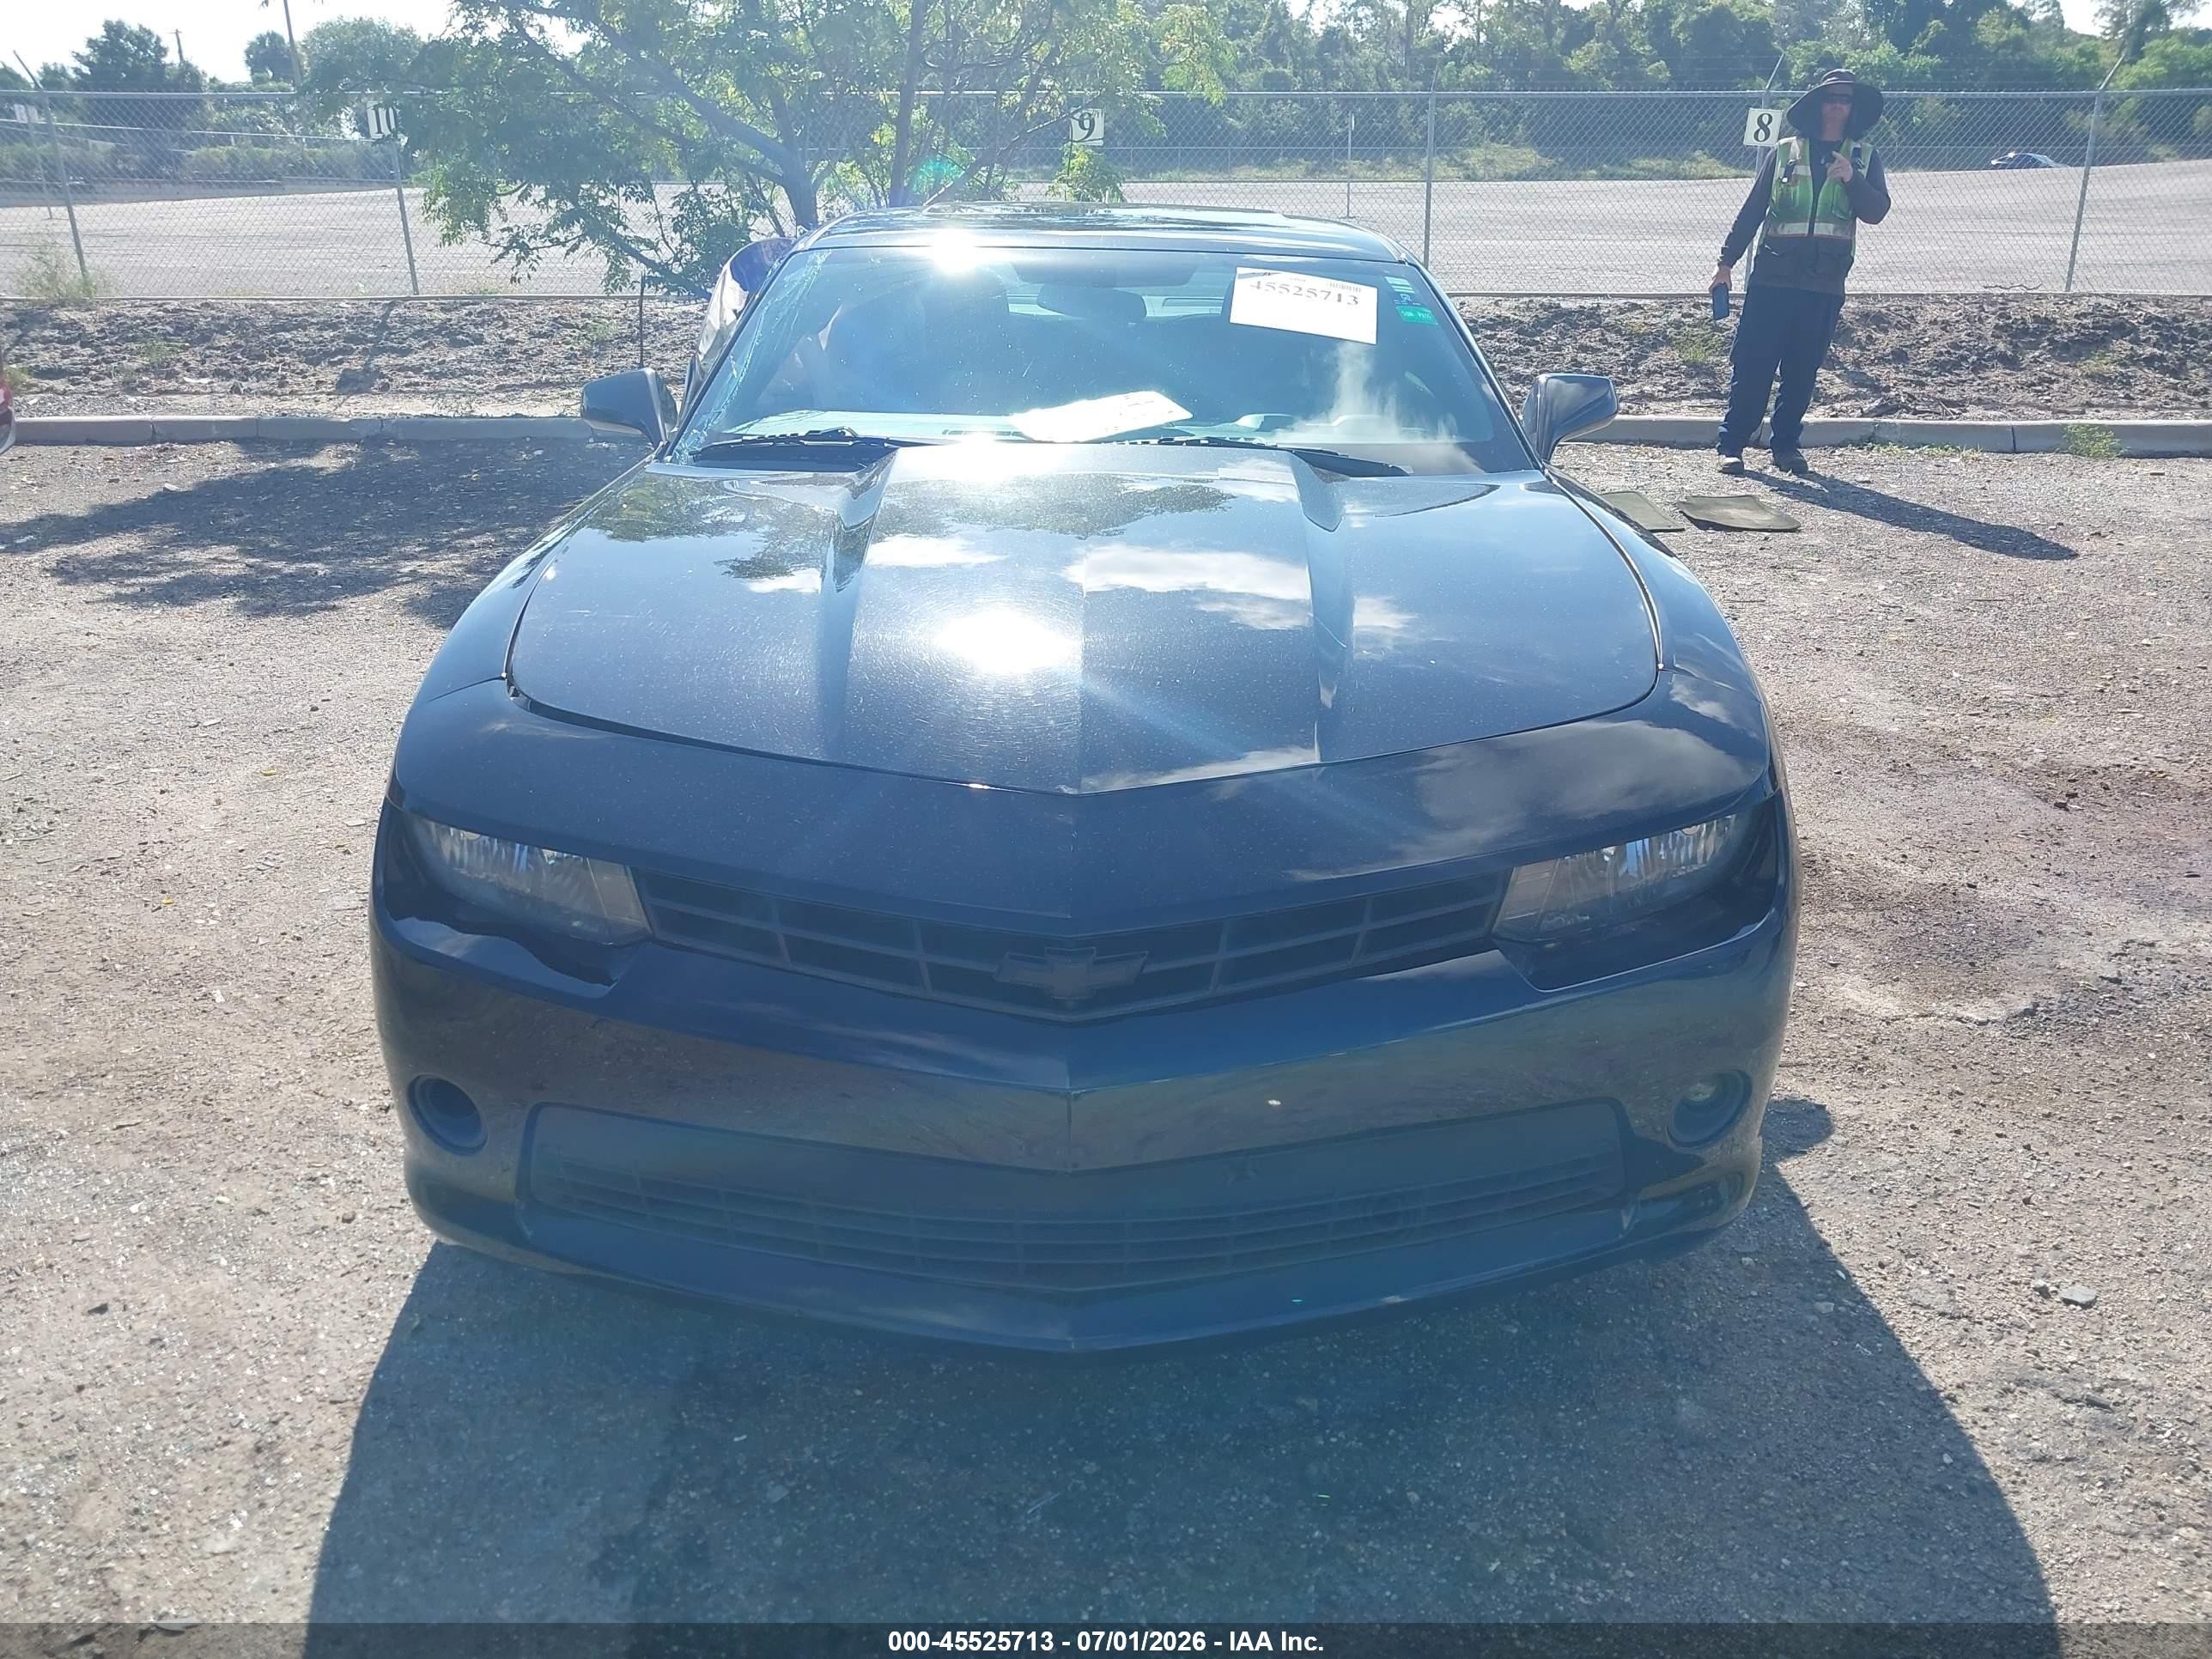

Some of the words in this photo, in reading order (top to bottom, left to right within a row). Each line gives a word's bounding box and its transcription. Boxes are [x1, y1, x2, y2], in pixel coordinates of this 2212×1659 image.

[374, 105, 398, 136] 10
[1078, 112, 1096, 142] 9
[1753, 112, 1773, 143] 8
[1249, 280, 1359, 307] 45525713
